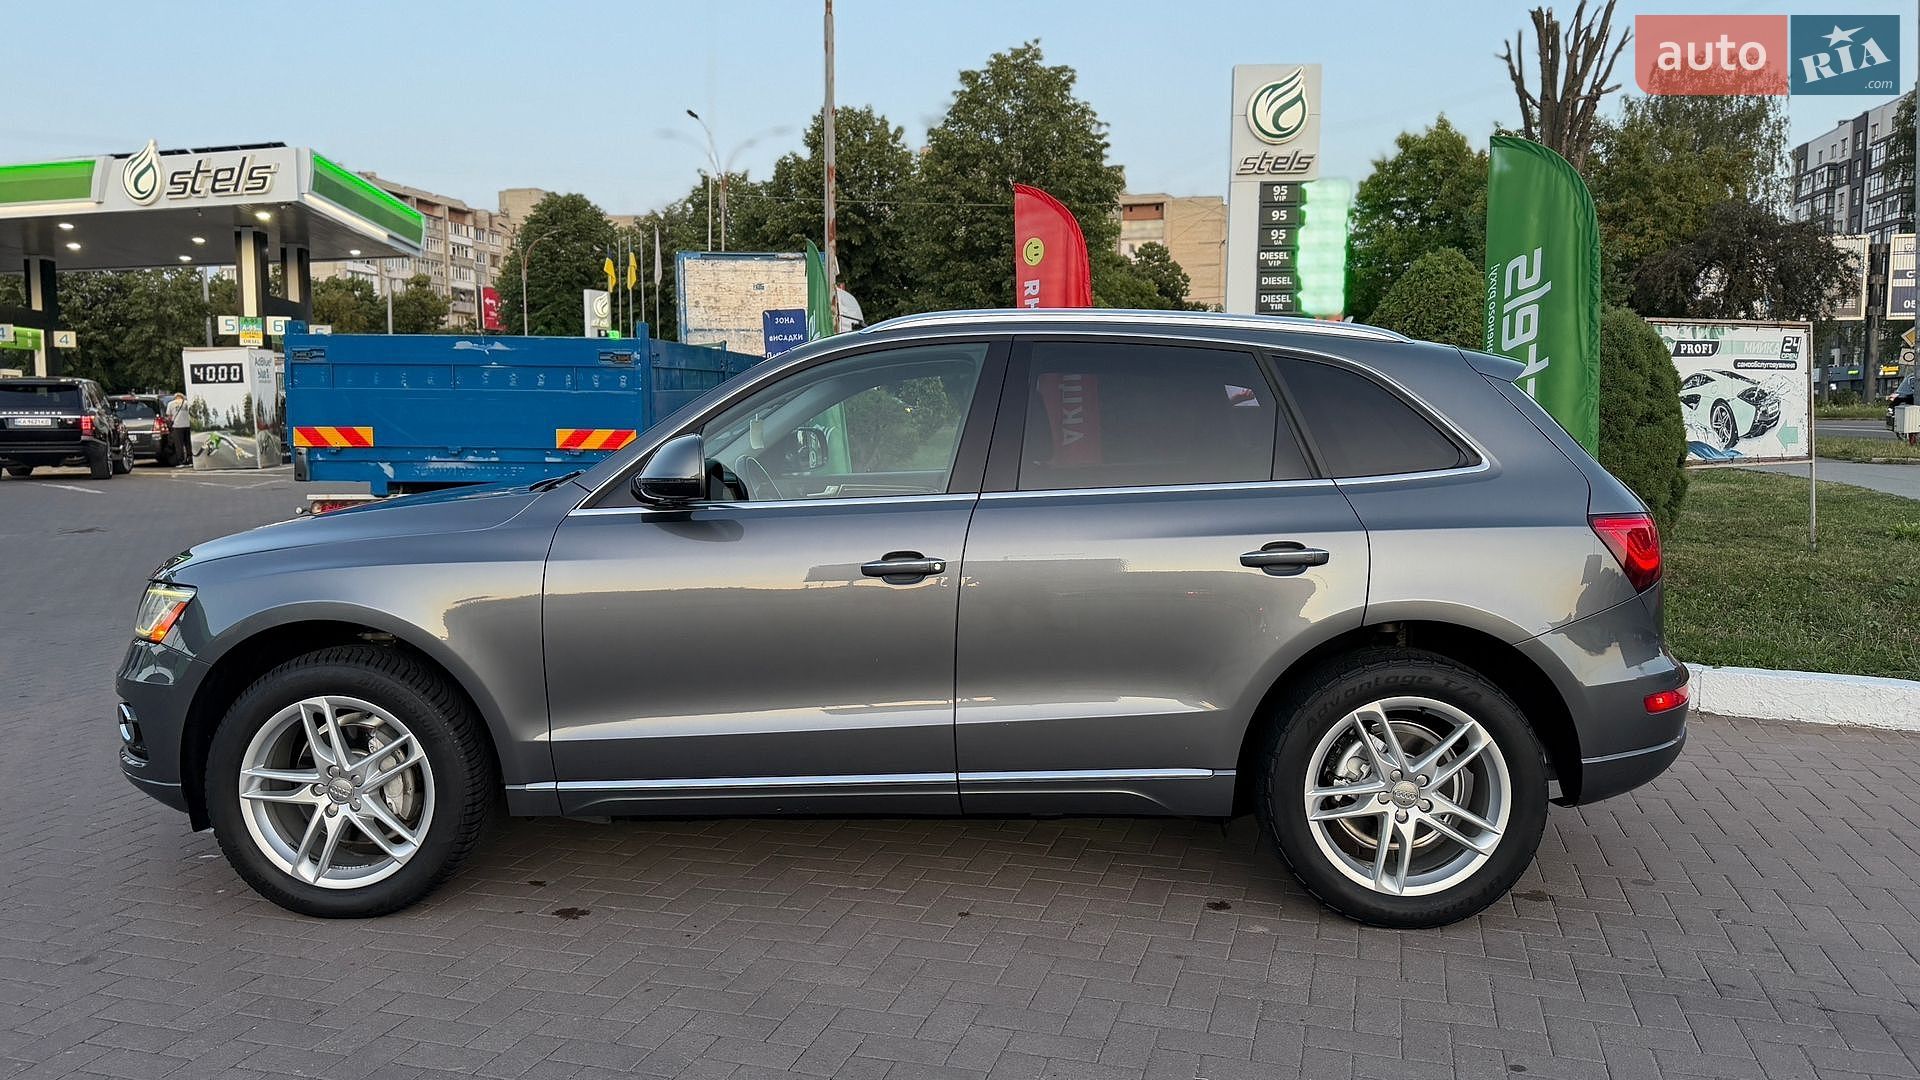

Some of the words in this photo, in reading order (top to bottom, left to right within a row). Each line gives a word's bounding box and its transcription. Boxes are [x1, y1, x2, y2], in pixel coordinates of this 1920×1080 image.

[1235, 150, 1316, 176] stels
[166, 155, 278, 199] stels
[1272, 185, 1288, 196] 95
[1271, 210, 1287, 221] 95
[1270, 229, 1286, 240] 95
[1259, 252, 1289, 260] DIESEL
[1261, 277, 1293, 285] DIESEL
[1260, 295, 1292, 303] DIESEL
[224, 318, 236, 332] 5
[273, 319, 284, 332] 6
[60, 334, 69, 344] 4
[1782, 337, 1801, 352] 24
[1680, 343, 1713, 354] PROFI
[194, 365, 240, 383] 40.00
